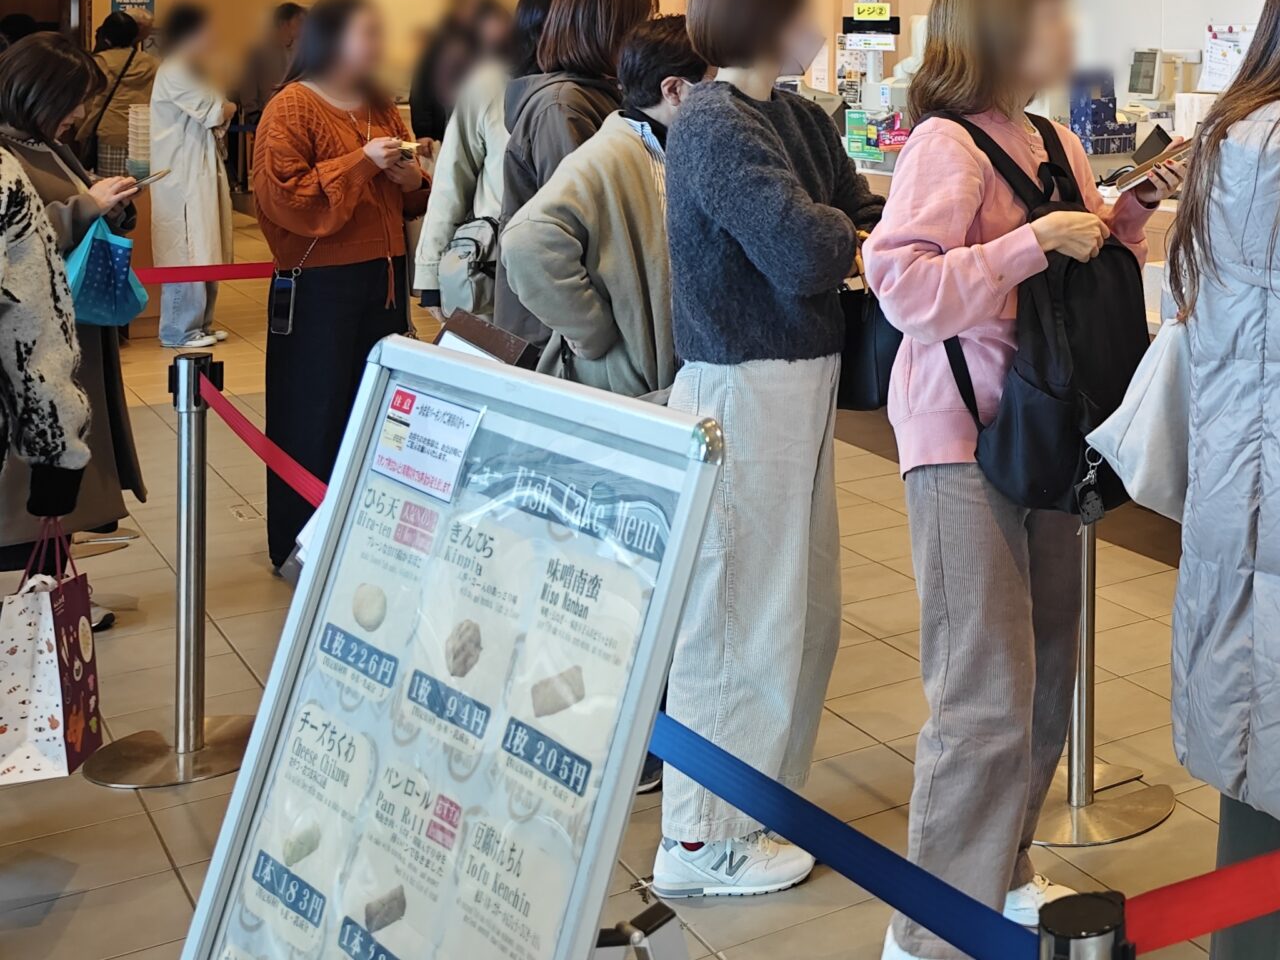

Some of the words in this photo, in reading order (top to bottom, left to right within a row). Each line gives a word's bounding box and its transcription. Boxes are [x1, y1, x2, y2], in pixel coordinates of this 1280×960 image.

[364, 487, 400, 520] ひら天
[512, 466, 551, 515] Fish
[562, 482, 605, 534] Cake
[612, 499, 660, 554] Menu
[546, 557, 604, 603] 味噌南蛮
[347, 642, 396, 685] 226円
[298, 711, 357, 764] チーズちくわ
[505, 723, 529, 758] 1枚
[533, 740, 588, 793] 205円
[375, 789, 396, 817] Pan
[401, 805, 425, 836] Rll
[277, 873, 326, 926] 183円
[466, 853, 490, 886] Tofu
[491, 871, 531, 918] Kenchin
